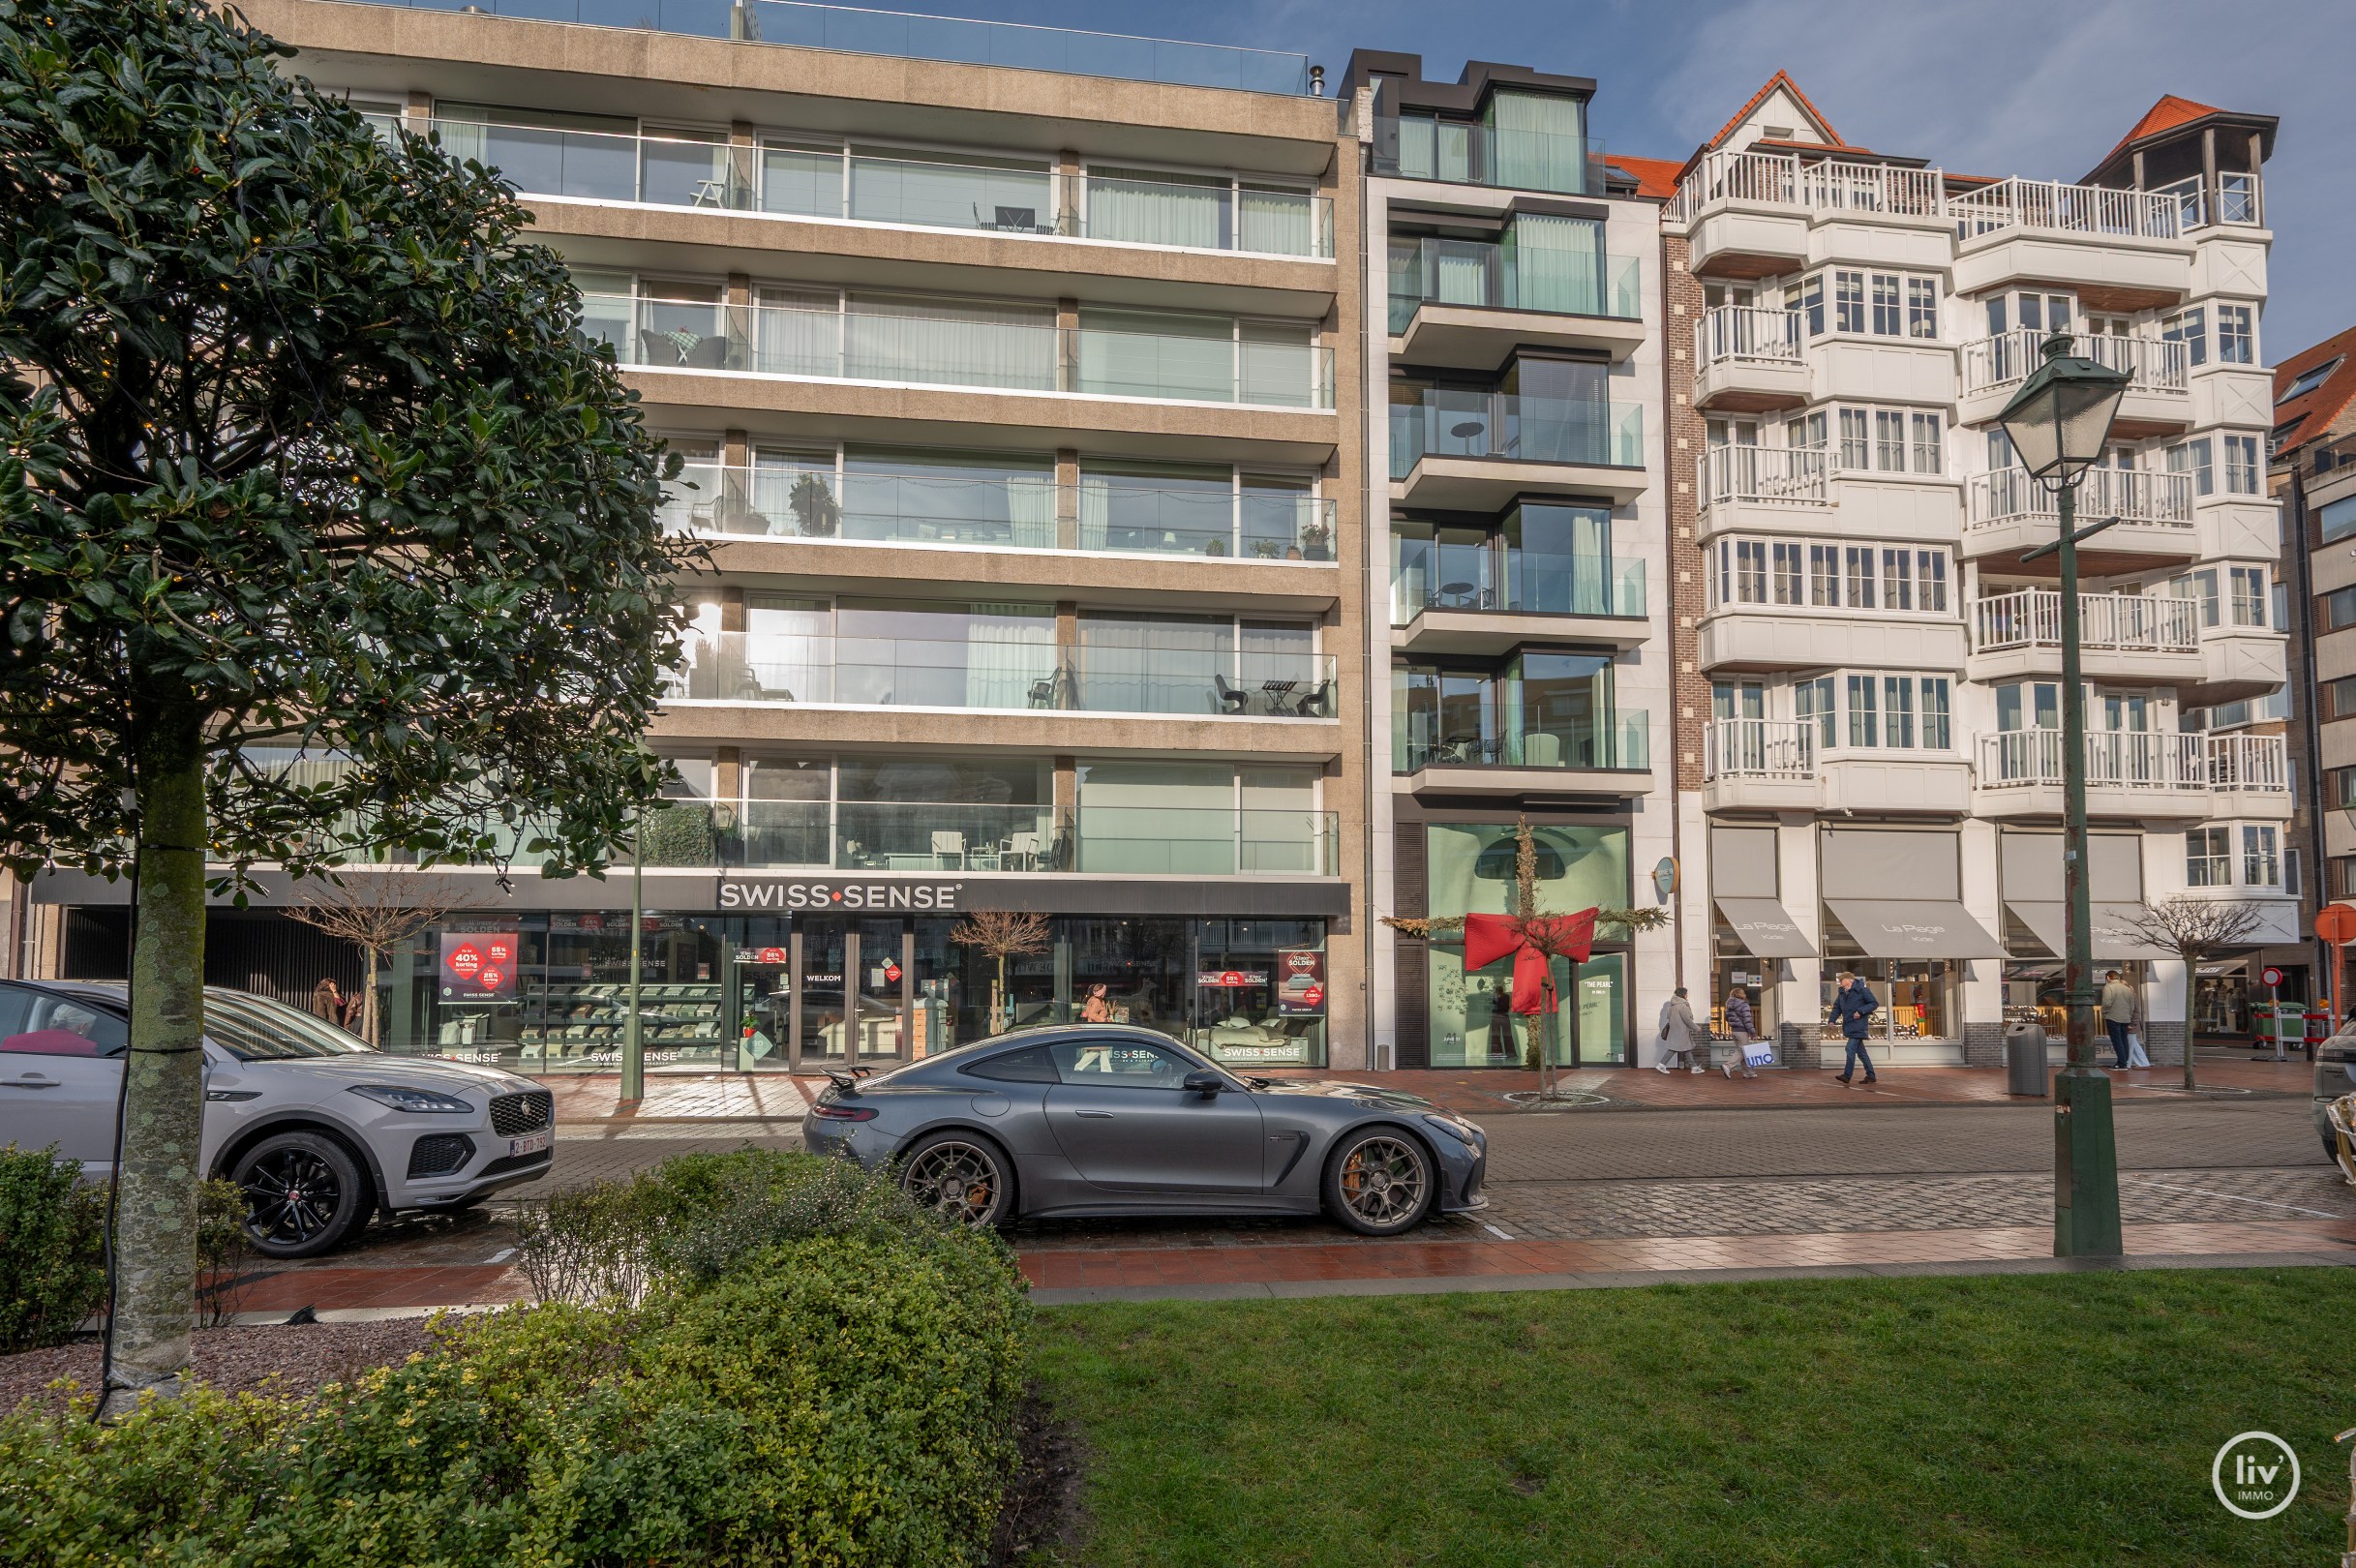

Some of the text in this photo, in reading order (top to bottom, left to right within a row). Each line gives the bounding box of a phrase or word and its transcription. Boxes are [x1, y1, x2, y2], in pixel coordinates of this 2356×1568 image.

[720, 884, 830, 907] SWISS
[1753, 922, 1797, 931] Plage
[1881, 924, 1946, 933] La Plage
[591, 1052, 677, 1061] SWIS ENSE
